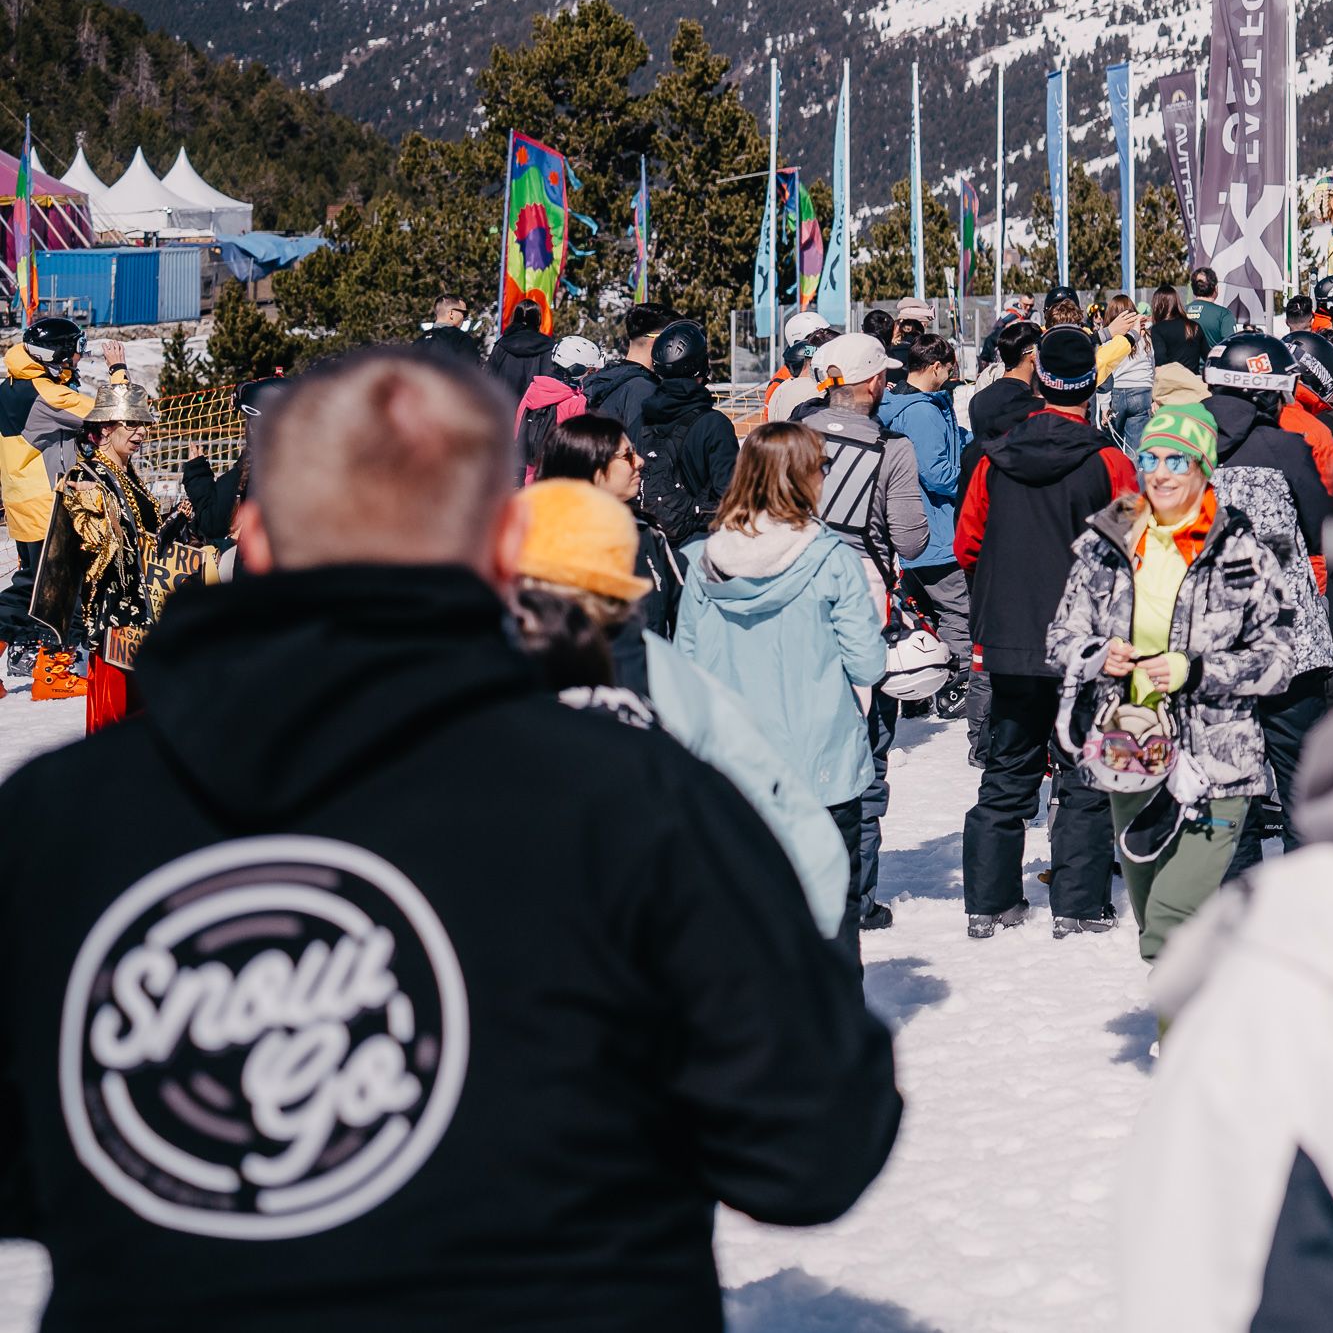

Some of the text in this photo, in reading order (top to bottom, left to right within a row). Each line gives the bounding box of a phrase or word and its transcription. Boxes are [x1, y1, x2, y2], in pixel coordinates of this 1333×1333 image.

[1064, 378, 1090, 391] SPECT
[1223, 373, 1272, 388] SPECT
[90, 927, 397, 1070] Snow
[242, 1021, 423, 1187] Go
